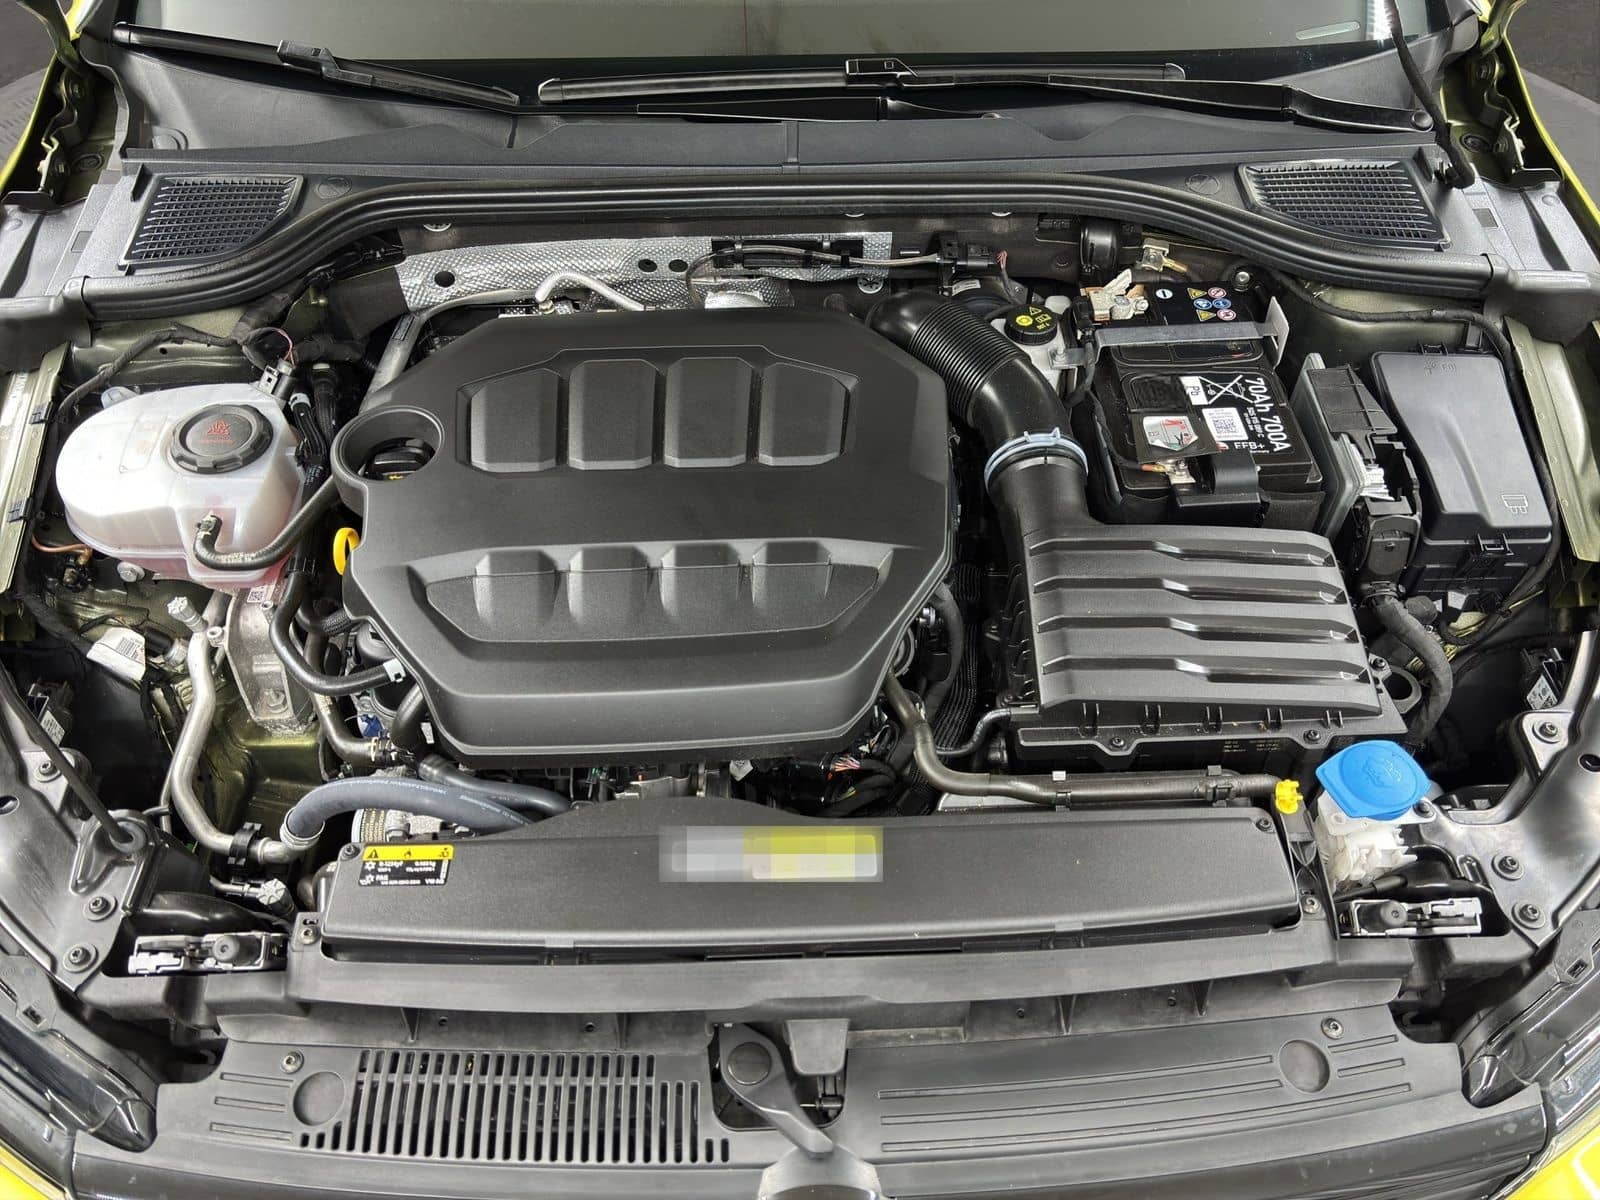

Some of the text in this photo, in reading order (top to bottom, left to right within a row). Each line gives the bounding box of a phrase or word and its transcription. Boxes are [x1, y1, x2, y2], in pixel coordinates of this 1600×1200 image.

[1189, 386, 1200, 396] Pb
[1245, 377, 1291, 452] 70Ah 700A
